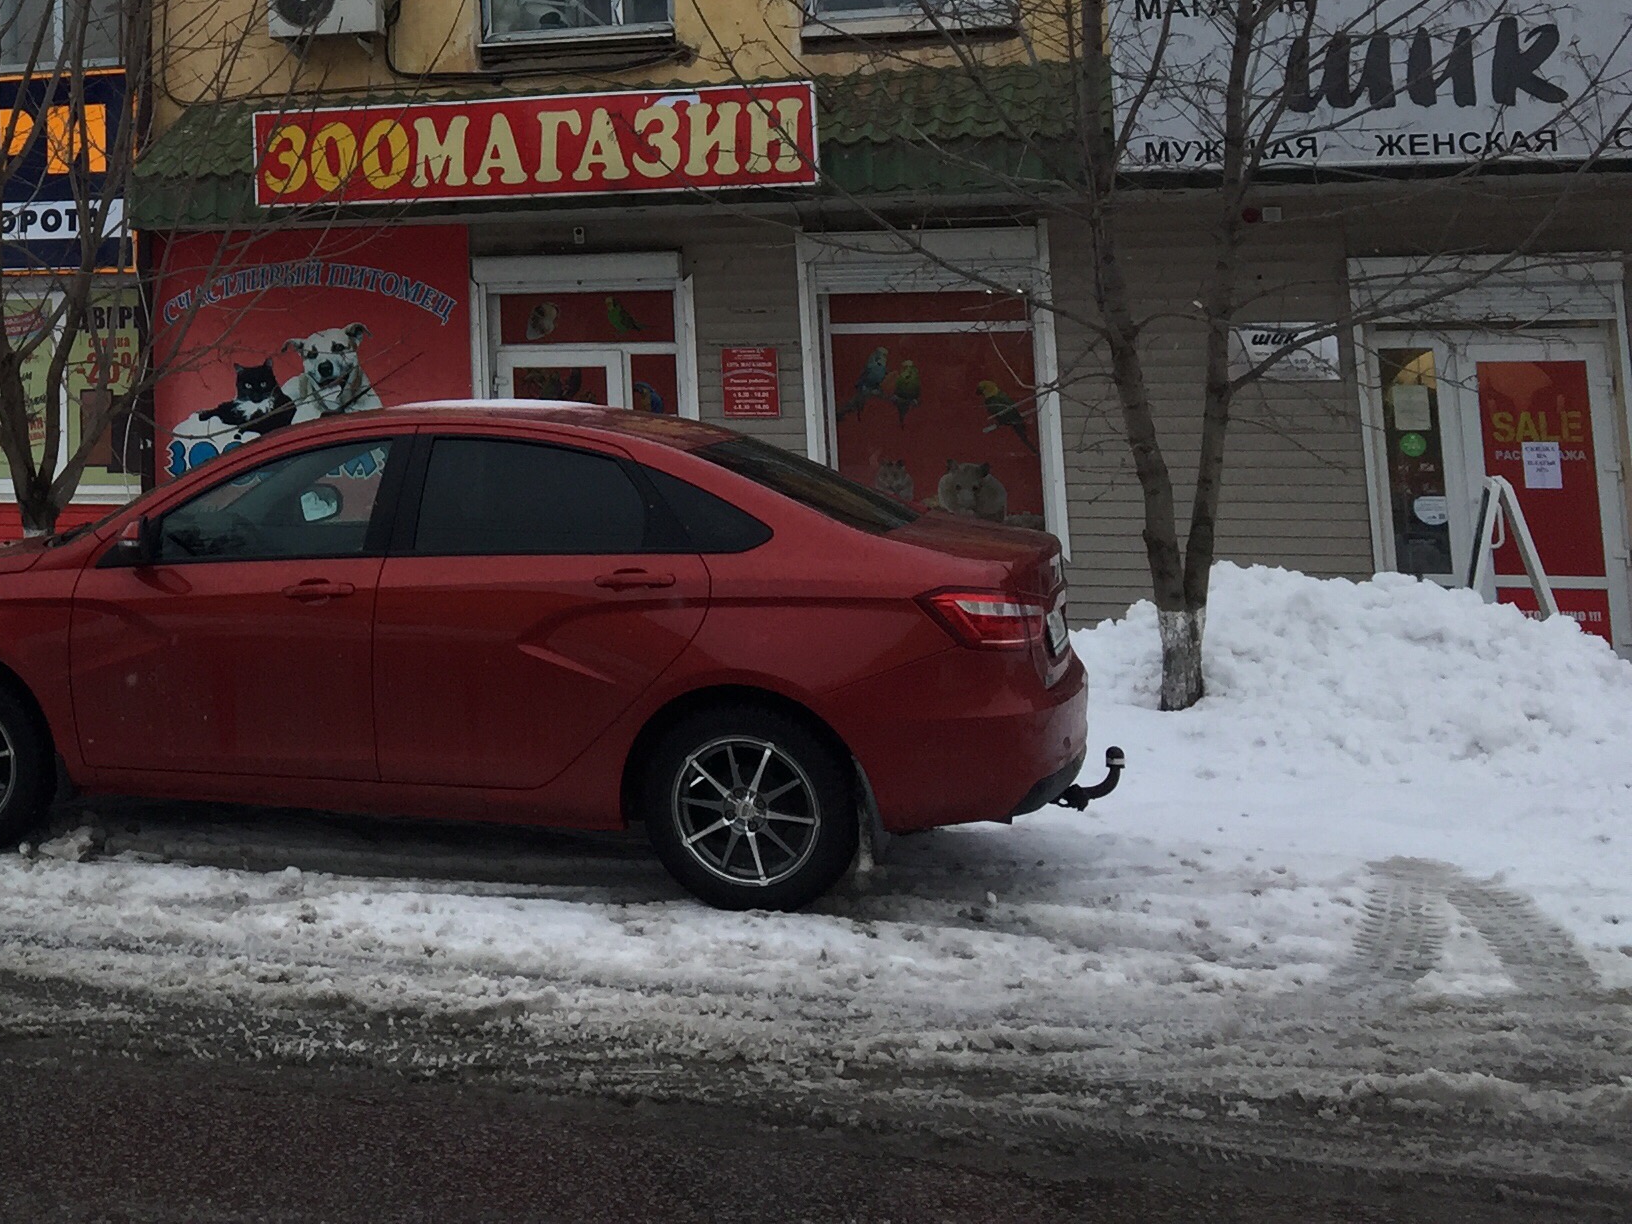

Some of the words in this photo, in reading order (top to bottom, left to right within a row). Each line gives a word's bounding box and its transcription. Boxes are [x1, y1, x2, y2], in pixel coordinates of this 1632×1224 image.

[264, 96, 805, 195] ЗООМАГАЗИН
[1374, 129, 1558, 157] ЖЕНСКАЯ
[325, 263, 458, 327] ПИТОМЕЦ
[1491, 410, 1585, 443] SALE
